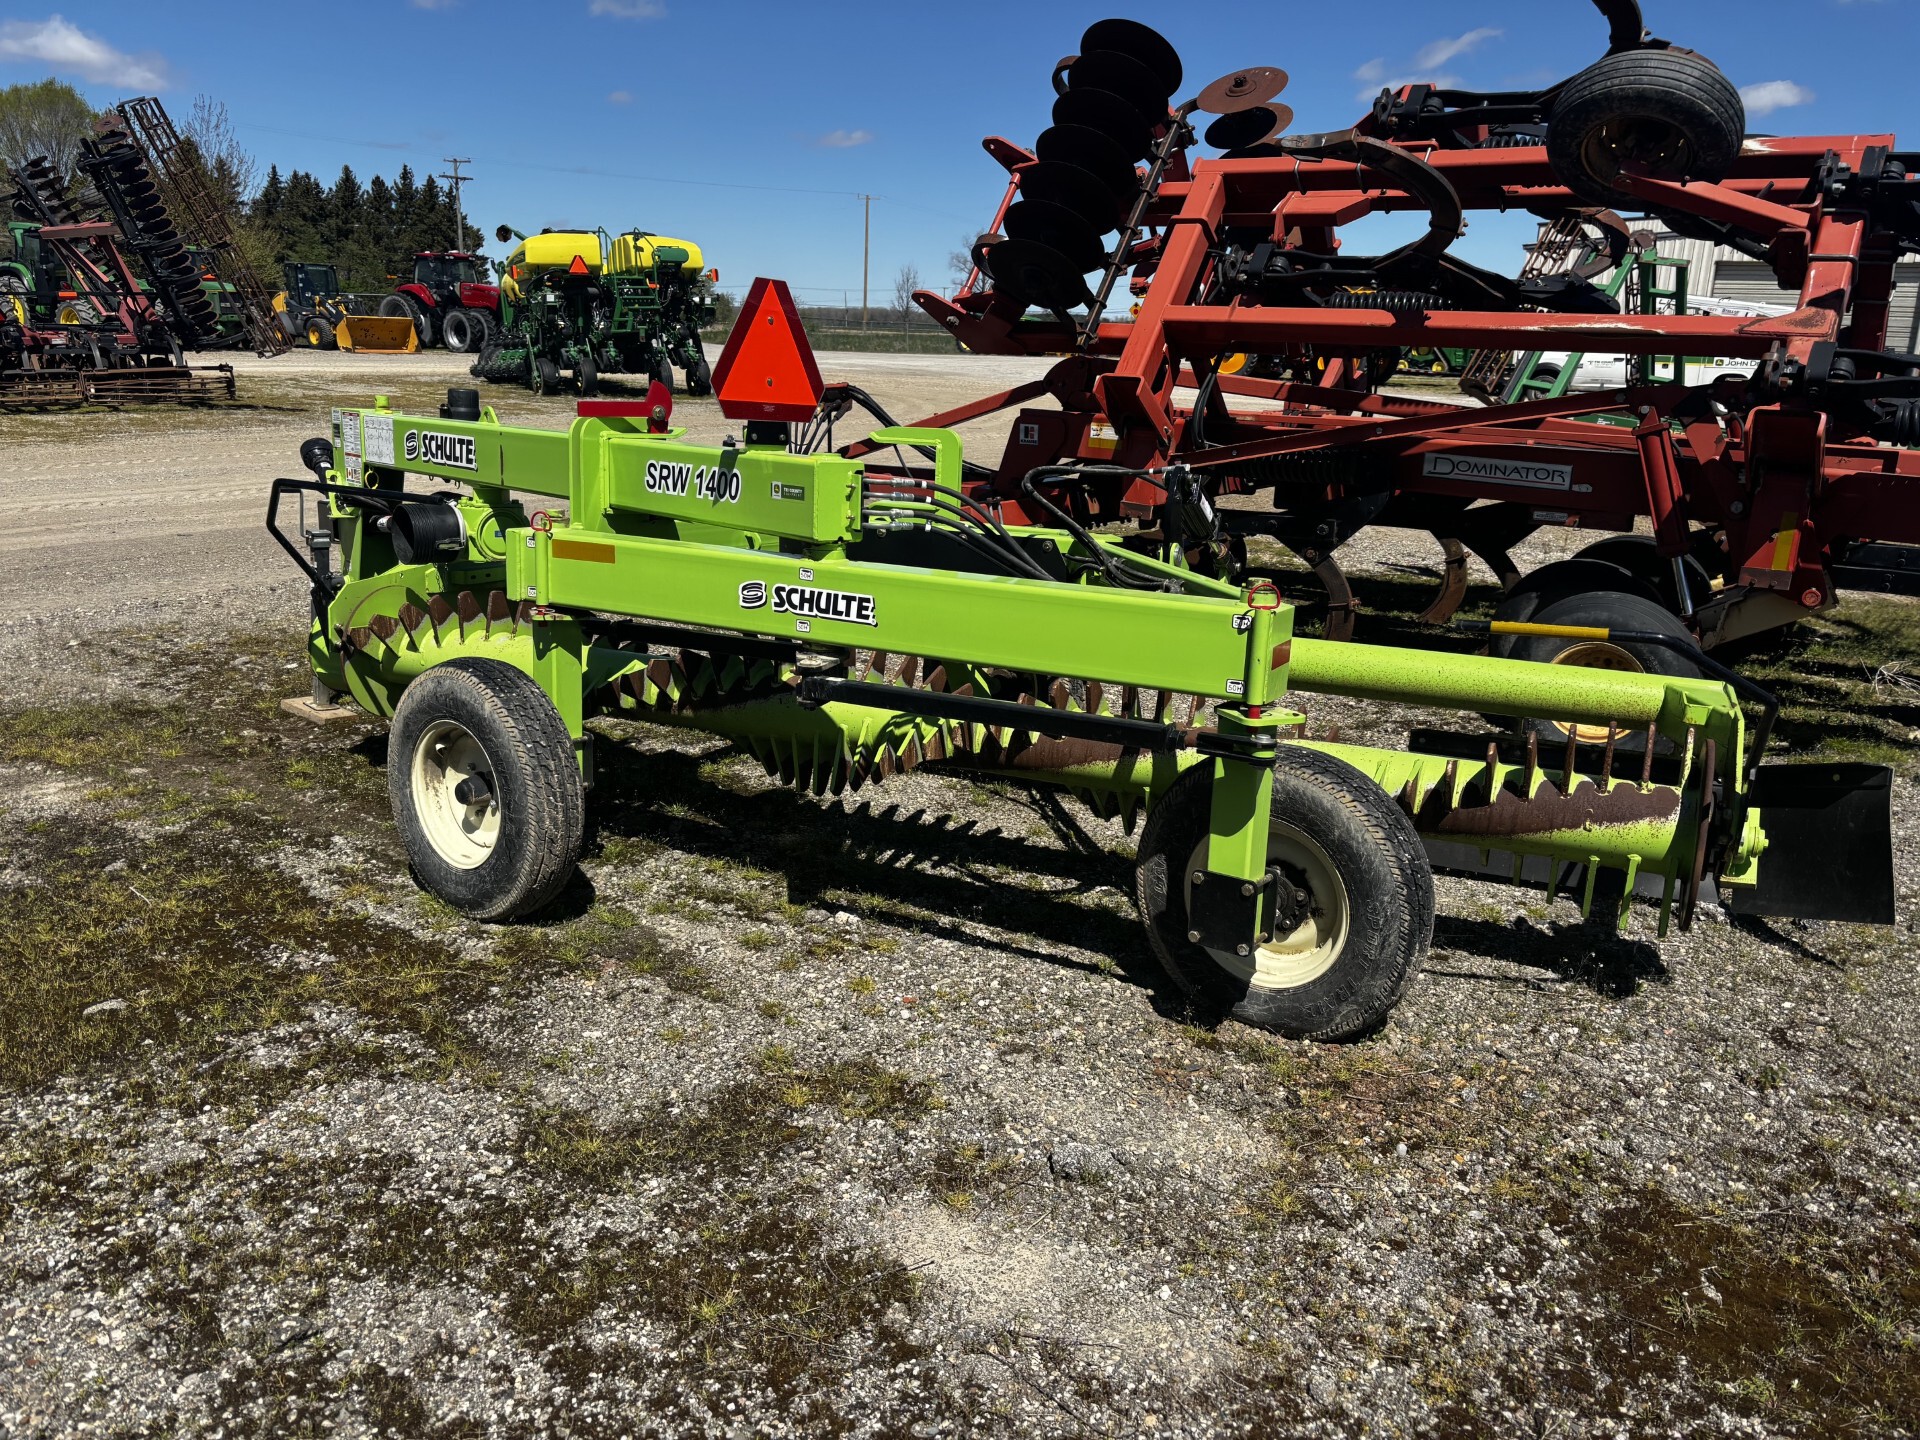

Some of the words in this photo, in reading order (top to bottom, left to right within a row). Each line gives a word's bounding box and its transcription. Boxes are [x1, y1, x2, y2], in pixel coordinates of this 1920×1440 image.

[422, 433, 474, 465] SCHULTE
[646, 462, 691, 494] SRW
[696, 468, 740, 501] 1400
[1426, 456, 1566, 483] DOMINATOR
[773, 585, 872, 621] SCHULTE
